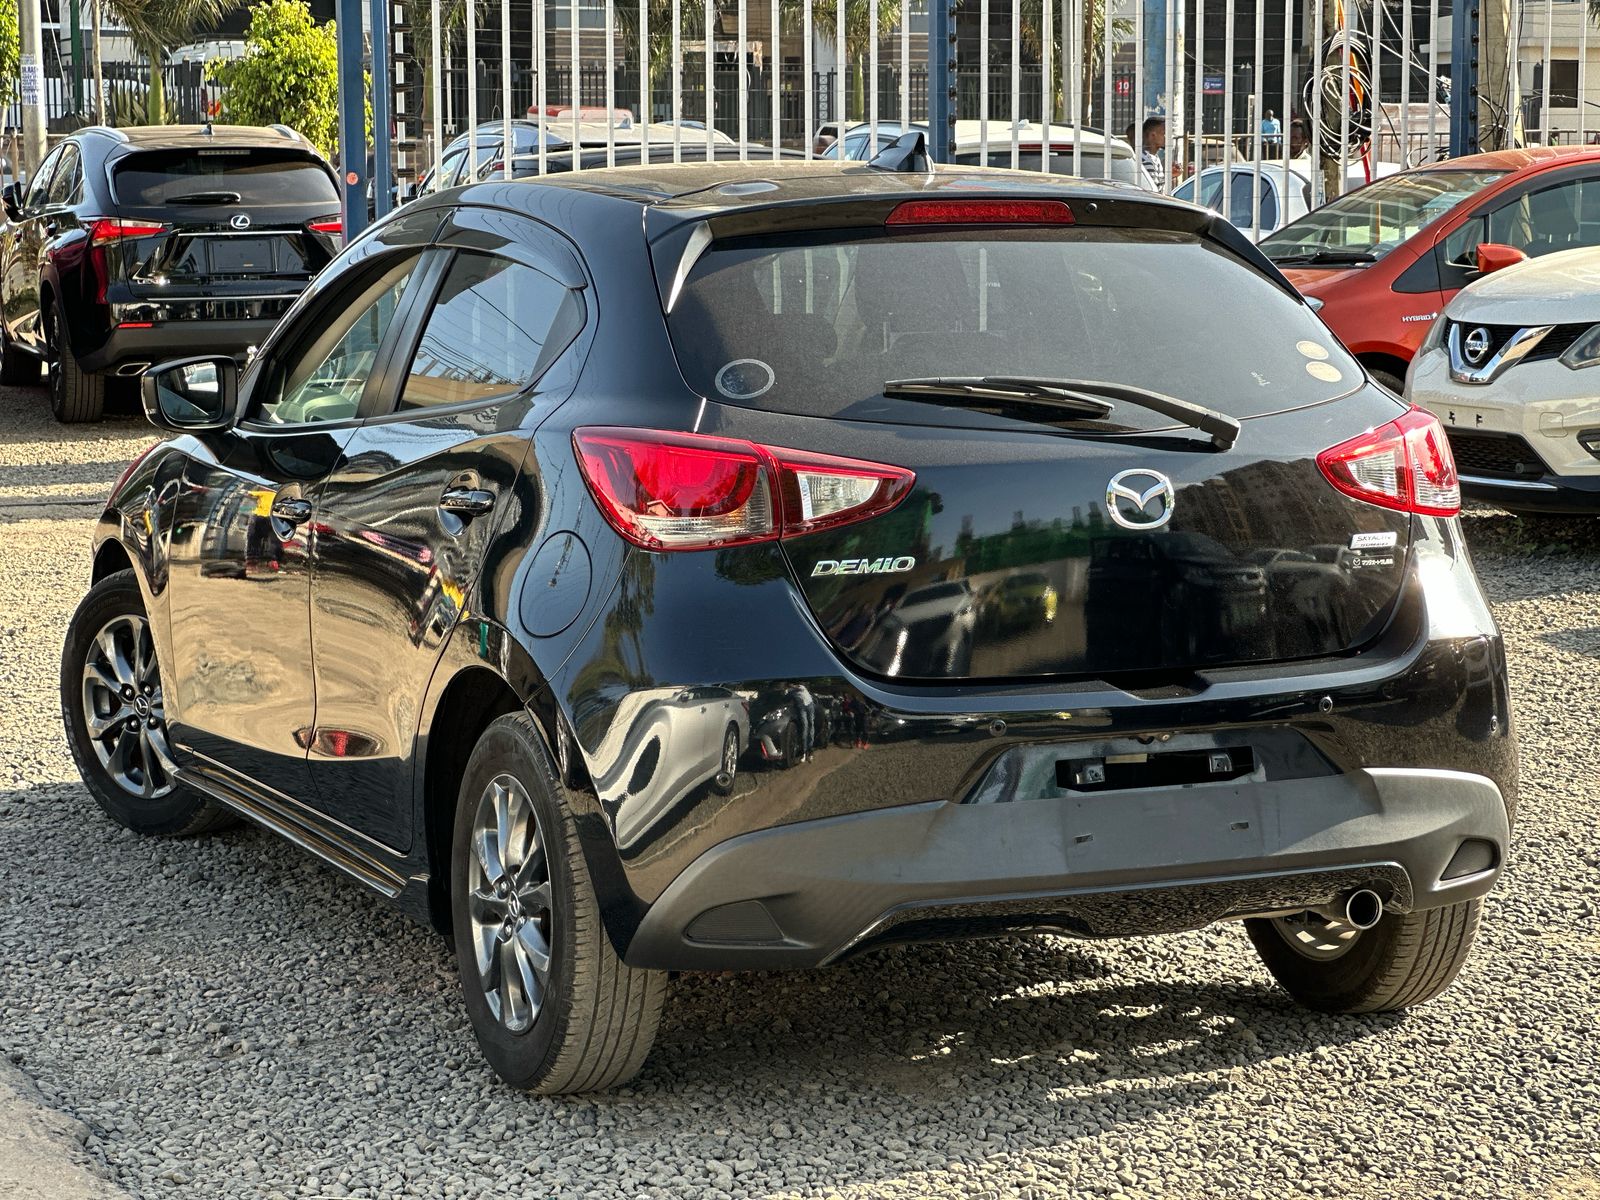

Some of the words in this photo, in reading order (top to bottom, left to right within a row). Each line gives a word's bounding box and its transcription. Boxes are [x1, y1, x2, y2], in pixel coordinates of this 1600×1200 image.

[1118, 81, 1130, 90] 10
[1402, 314, 1431, 322] HYBRID
[810, 556, 916, 577] DEMIO
